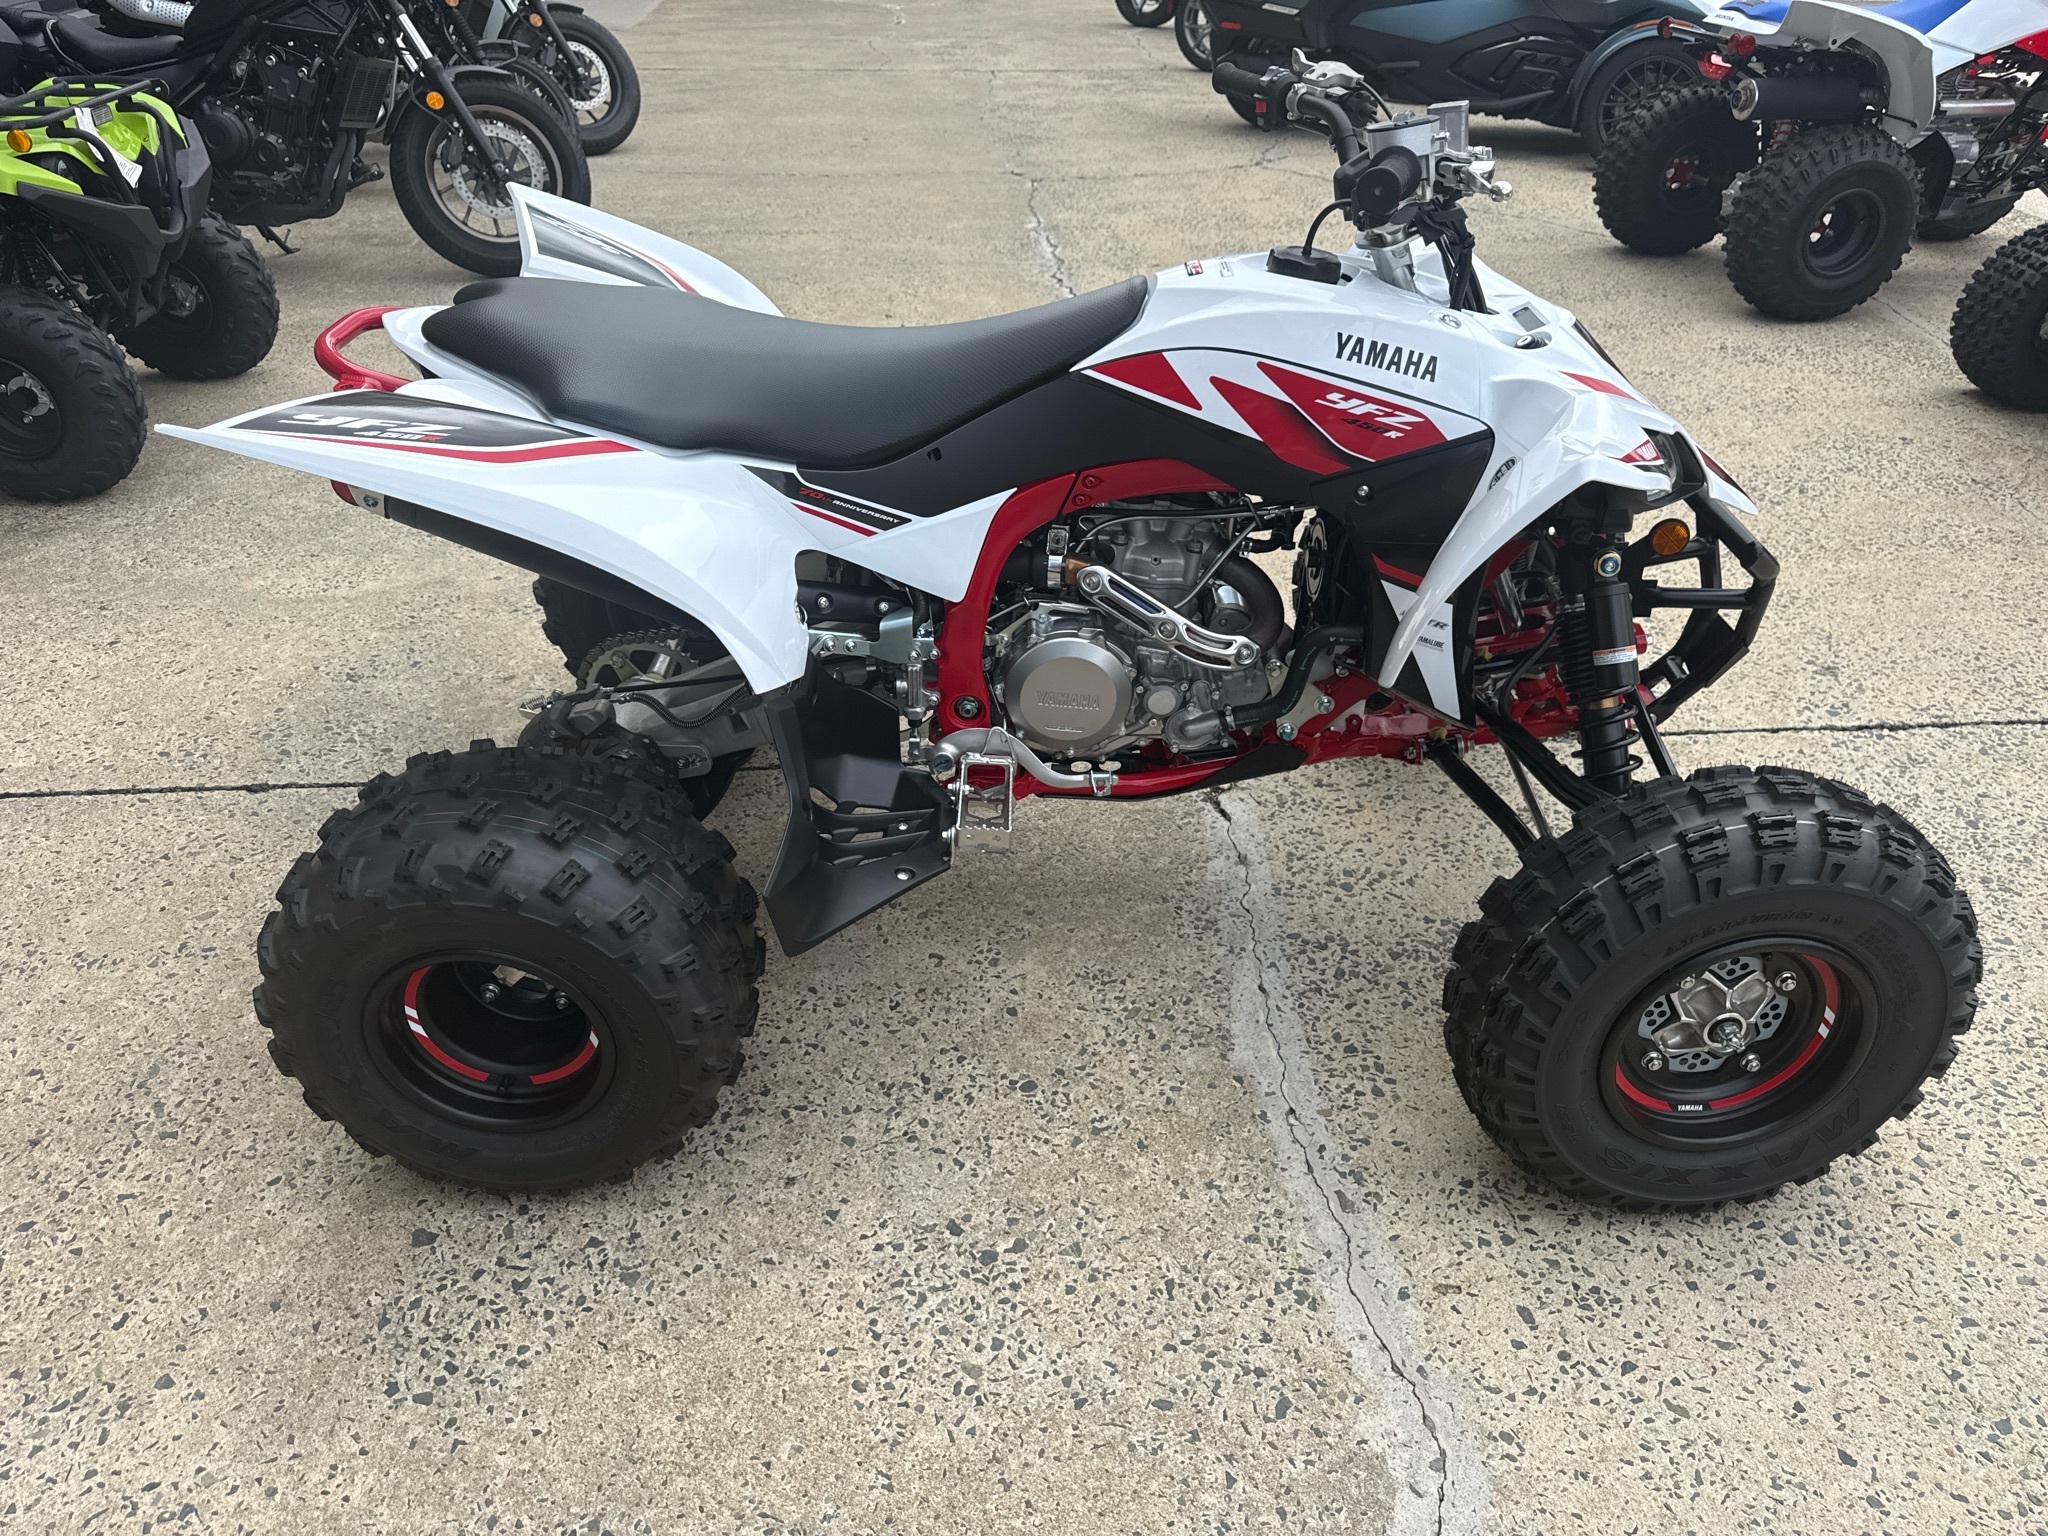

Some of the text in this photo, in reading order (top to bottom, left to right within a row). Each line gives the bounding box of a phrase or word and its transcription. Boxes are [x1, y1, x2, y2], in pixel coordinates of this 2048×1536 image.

[1336, 331, 1438, 383] YAMAHA
[1314, 392, 1426, 430] YFZ
[277, 413, 463, 437] YFZ
[1340, 418, 1405, 439] 450R
[353, 431, 445, 442] 450R
[832, 500, 901, 523] ANNIVERSARY
[1417, 635, 1445, 649] AMALUBE
[1037, 690, 1100, 711] YAMAHA
[1677, 1104, 1703, 1112] YAMAHA
[1595, 1097, 1861, 1186] MAXXIS
